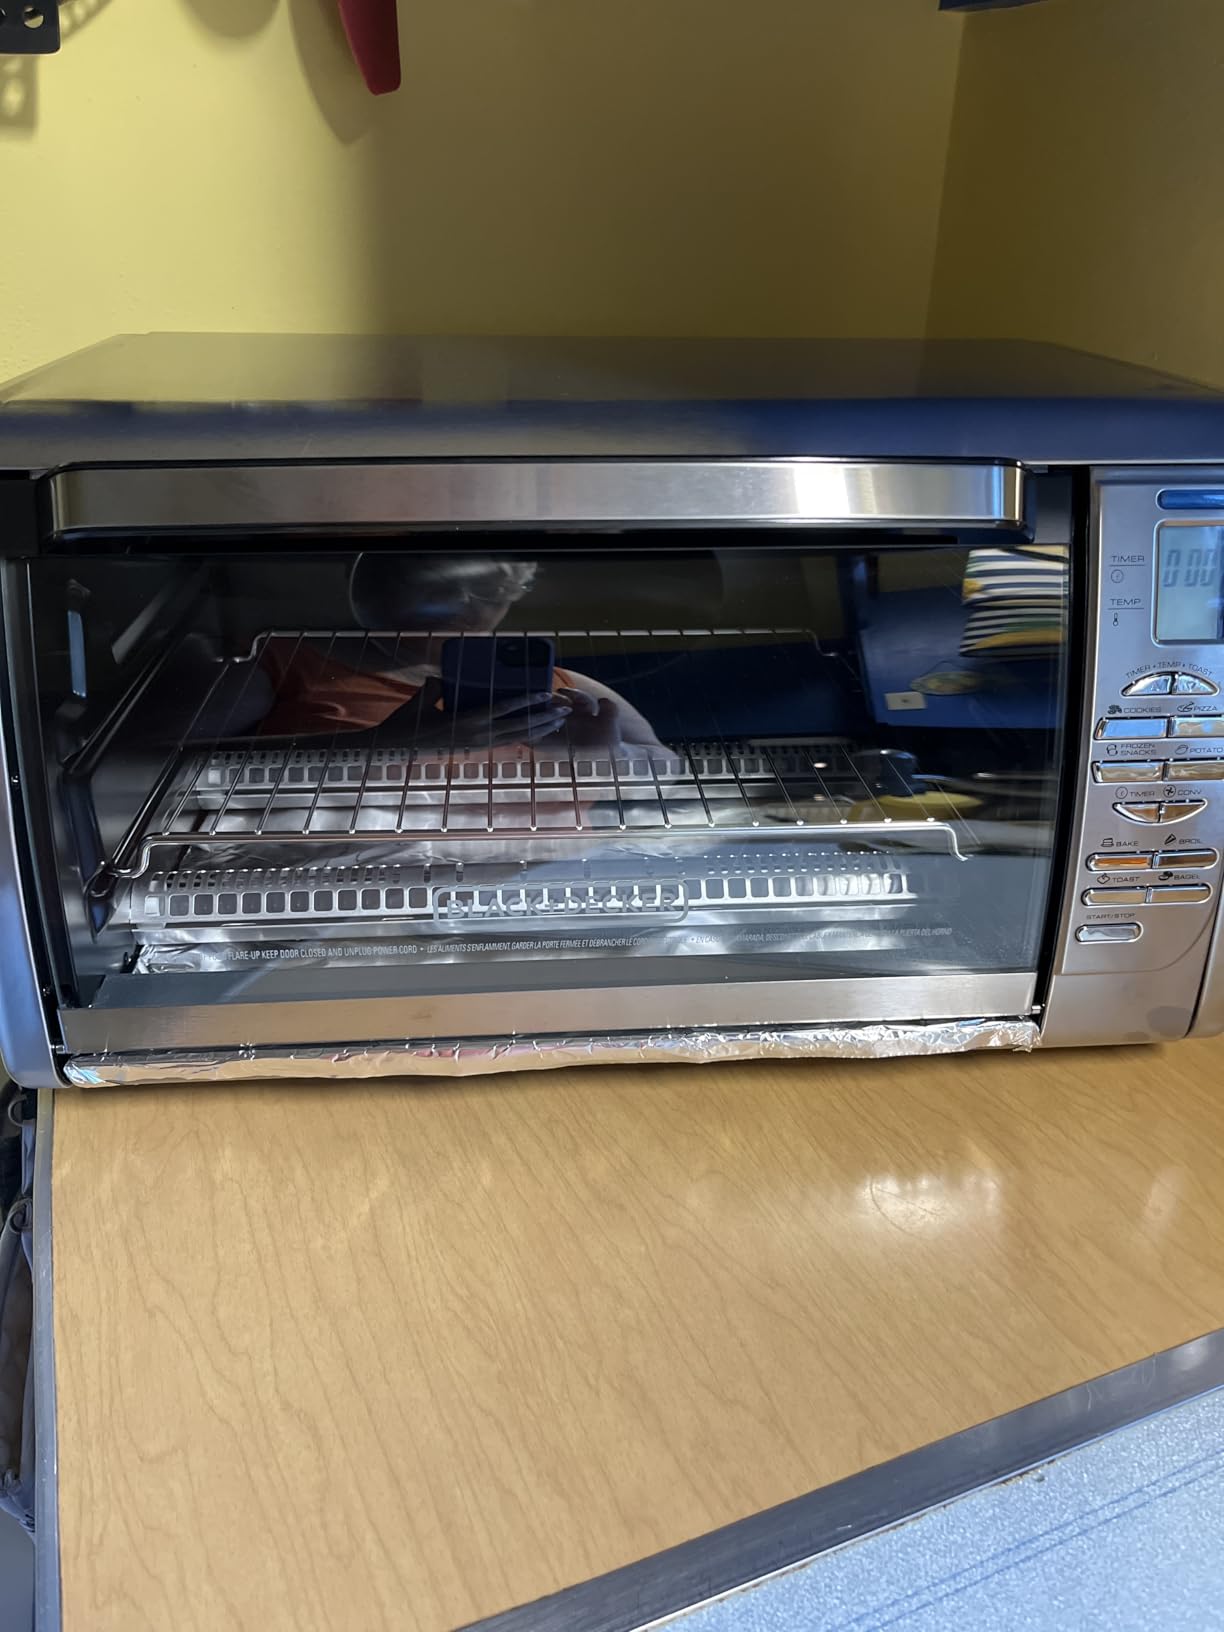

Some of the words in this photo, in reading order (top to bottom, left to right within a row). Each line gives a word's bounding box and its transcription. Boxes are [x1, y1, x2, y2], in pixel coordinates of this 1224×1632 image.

[1111, 555, 1145, 563] TIMER
[1110, 598, 1142, 606] TEMP
[1125, 664, 1151, 679] TIMER
[1158, 661, 1182, 669] TEMP
[1188, 663, 1213, 677] TOAST
[1123, 706, 1161, 714] COOKIES
[446, 891, 676, 919] BLACK+DECKER
[1086, 912, 1136, 920] START/STOP
[228, 950, 260, 960] FLARE-UP
[261, 949, 279, 959] KEEP
[279, 949, 300, 958] DOOR
[300, 948, 326, 958] CLOSED
[327, 947, 343, 957] AND
[343, 946, 372, 956] UNPLUG
[373, 945, 397, 955] POWER
[398, 945, 418, 954] CORD
